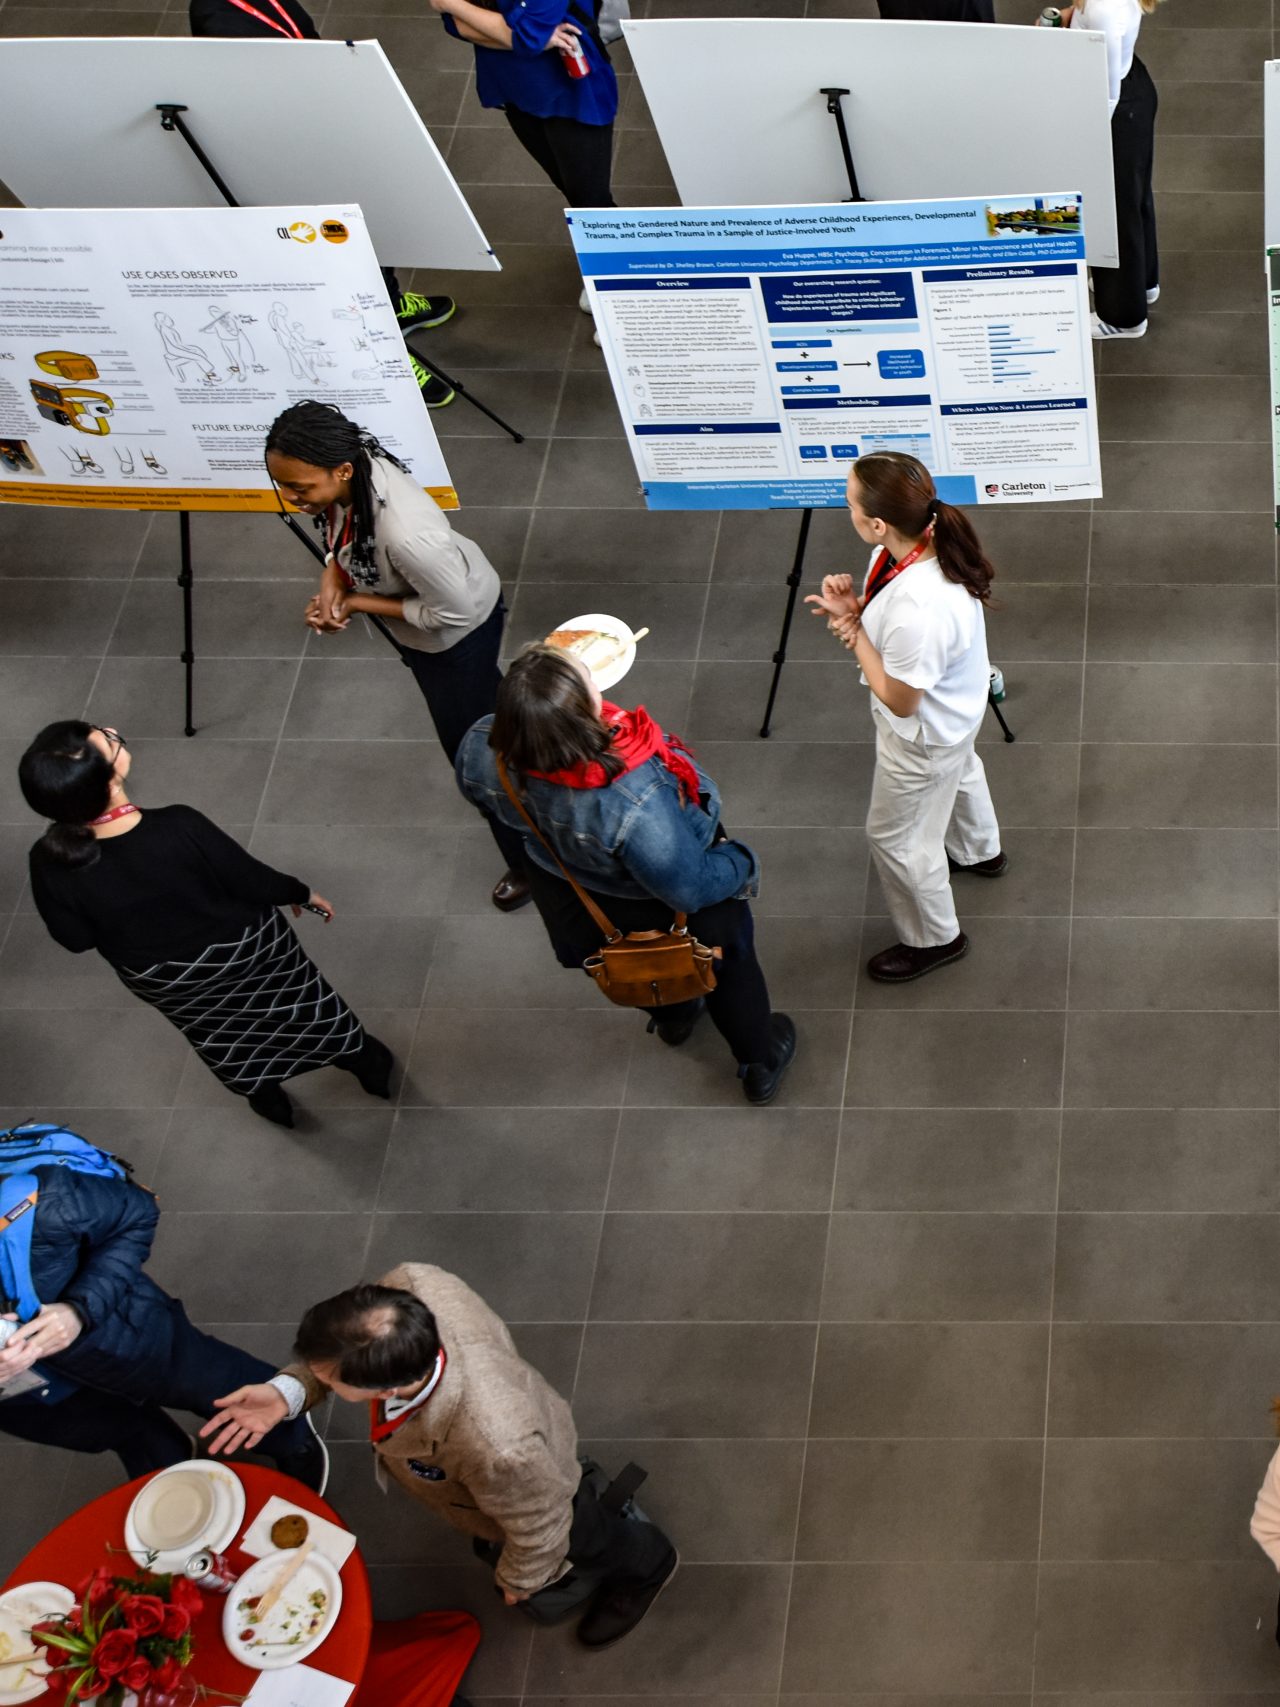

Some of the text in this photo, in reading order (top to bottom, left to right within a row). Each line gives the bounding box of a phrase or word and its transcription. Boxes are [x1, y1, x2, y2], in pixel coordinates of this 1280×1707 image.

[582, 221, 621, 231] Exploring
[638, 220, 678, 228] Gendered
[819, 215, 861, 224] Childhood
[862, 214, 913, 224] Experiences,
[915, 209, 976, 220] Developmental
[277, 227, 291, 239] CIL
[585, 232, 618, 241] Trauma,
[637, 231, 674, 240] Complex
[724, 229, 754, 238] Sample
[766, 226, 831, 236] Justice-Involved
[832, 225, 856, 234] Youth
[834, 251, 869, 259] Psychology,
[870, 248, 912, 256] Concentration
[122, 270, 238, 280] USE CASES OBSERVED
